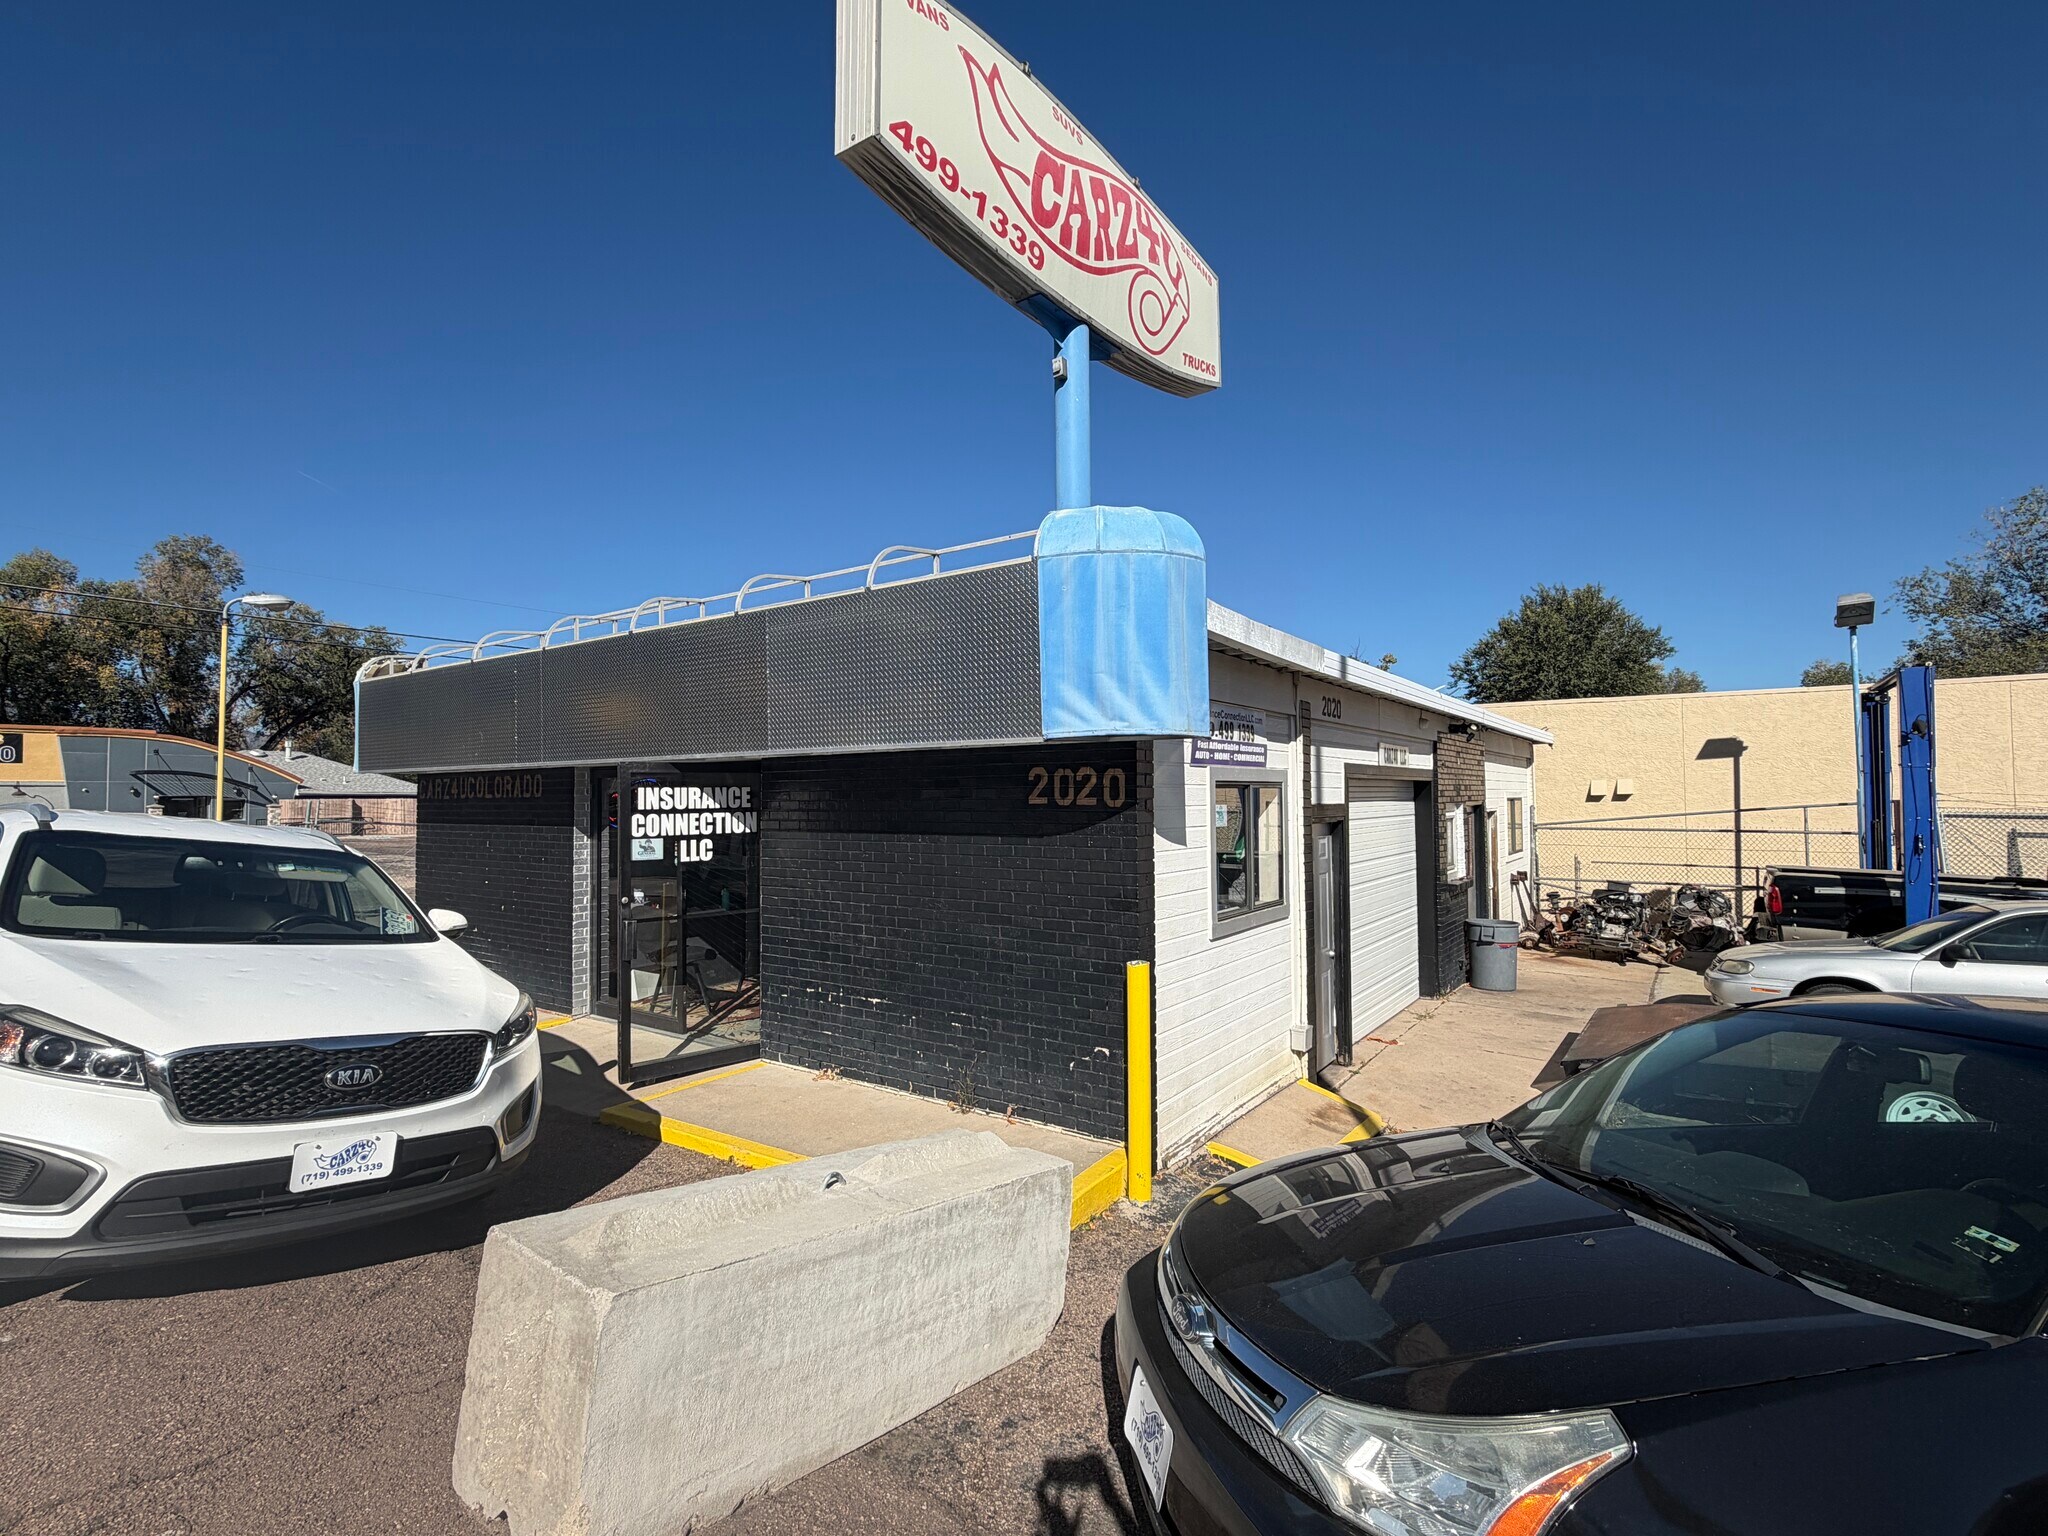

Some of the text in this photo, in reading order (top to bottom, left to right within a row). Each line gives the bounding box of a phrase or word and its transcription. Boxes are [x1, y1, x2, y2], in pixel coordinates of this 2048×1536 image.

[1051, 105, 1084, 146] SUVS
[888, 119, 1046, 271] 499-1339
[1180, 241, 1213, 287] SEDANS
[1182, 352, 1217, 377] TRUCKS
[1321, 695, 1342, 720] 2020
[419, 773, 543, 800] CARZ4UCOLORADO
[637, 786, 752, 811] INSURANCE
[1027, 766, 1126, 808] 2020
[631, 811, 758, 838] CONNECTION
[680, 838, 714, 863] LLC
[336, 1068, 375, 1086] KIA
[301, 1162, 384, 1185] (719) 499-1339
[1173, 1300, 1189, 1331] Ford
